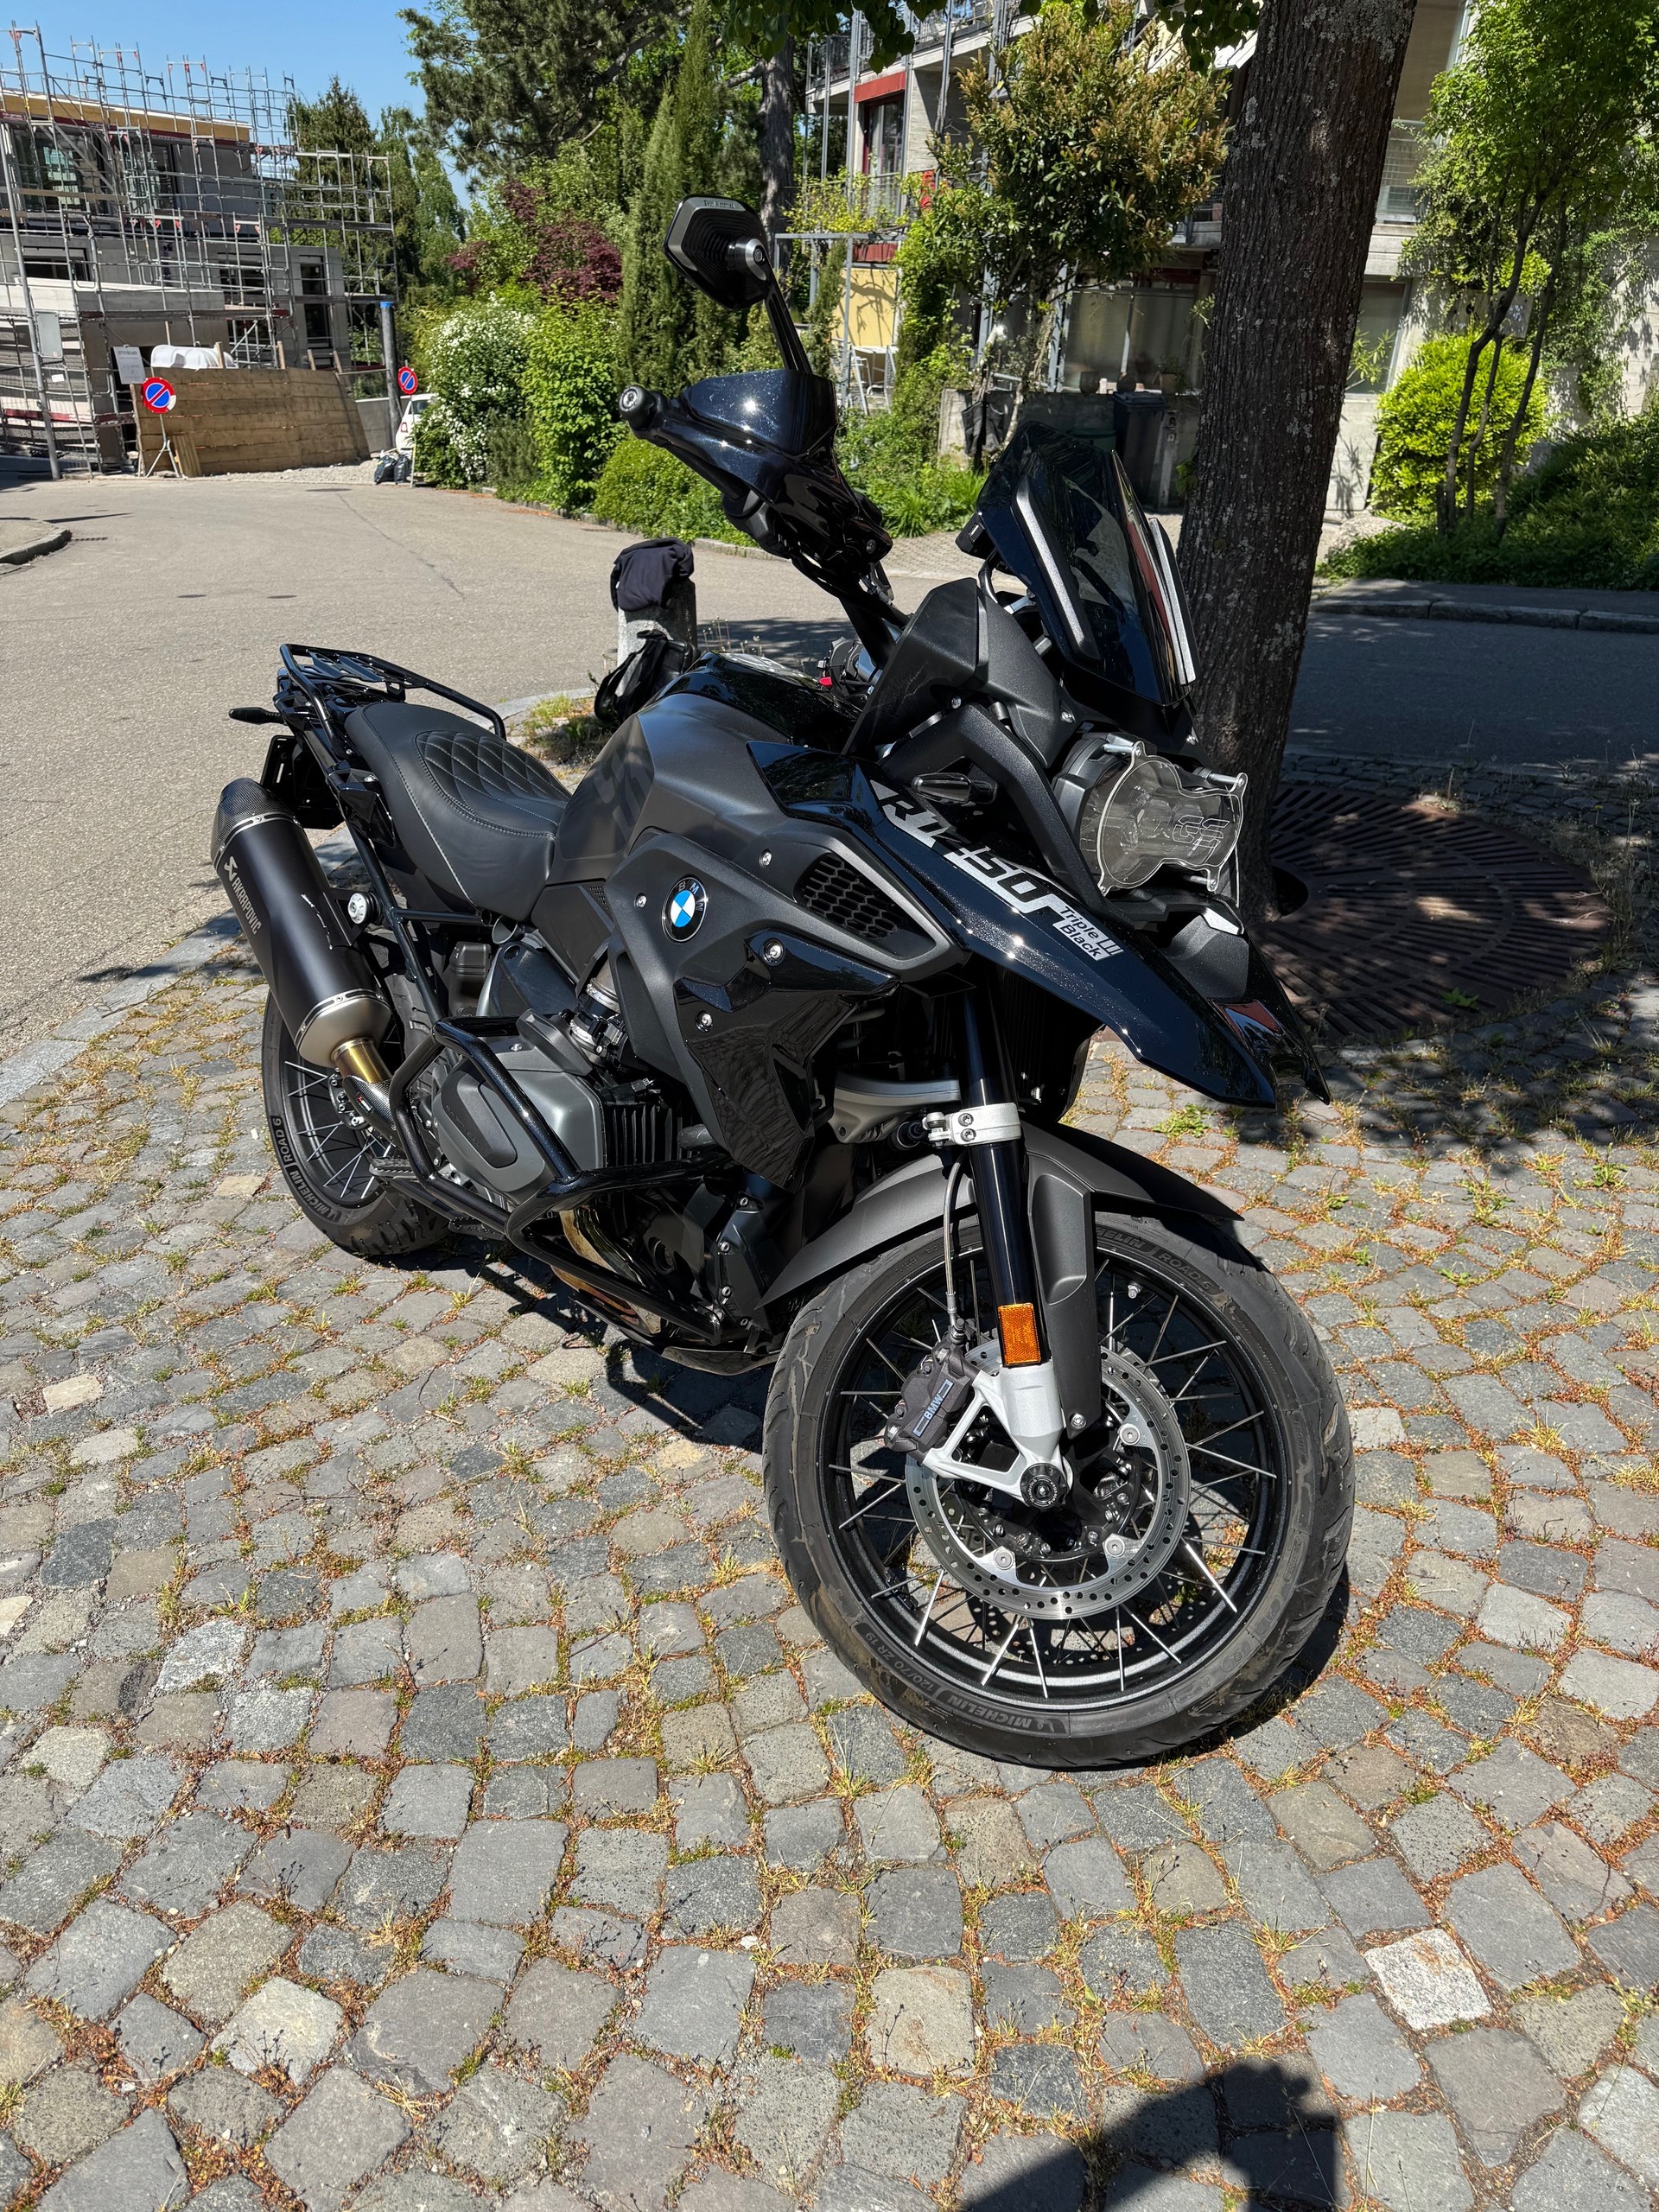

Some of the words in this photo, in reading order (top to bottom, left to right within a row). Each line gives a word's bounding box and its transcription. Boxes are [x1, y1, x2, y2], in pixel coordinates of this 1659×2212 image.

[678, 880, 704, 912] BMW
[1060, 906, 1099, 939] Triple
[1059, 925, 1102, 957] Black
[272, 1118, 283, 1127] 6
[276, 1129, 294, 1163] ROAD
[289, 1170, 329, 1215] MICHELIN
[1096, 1226, 1146, 1249] HELIN
[1158, 1253, 1202, 1283] ROAD
[1201, 1281, 1213, 1291] 6
[924, 1393, 944, 1421] BMW
[866, 1631, 878, 1643] 19
[878, 1645, 895, 1661] ZR
[895, 1660, 935, 1694] 120/70
[947, 1696, 1033, 1729] MICHELIN
